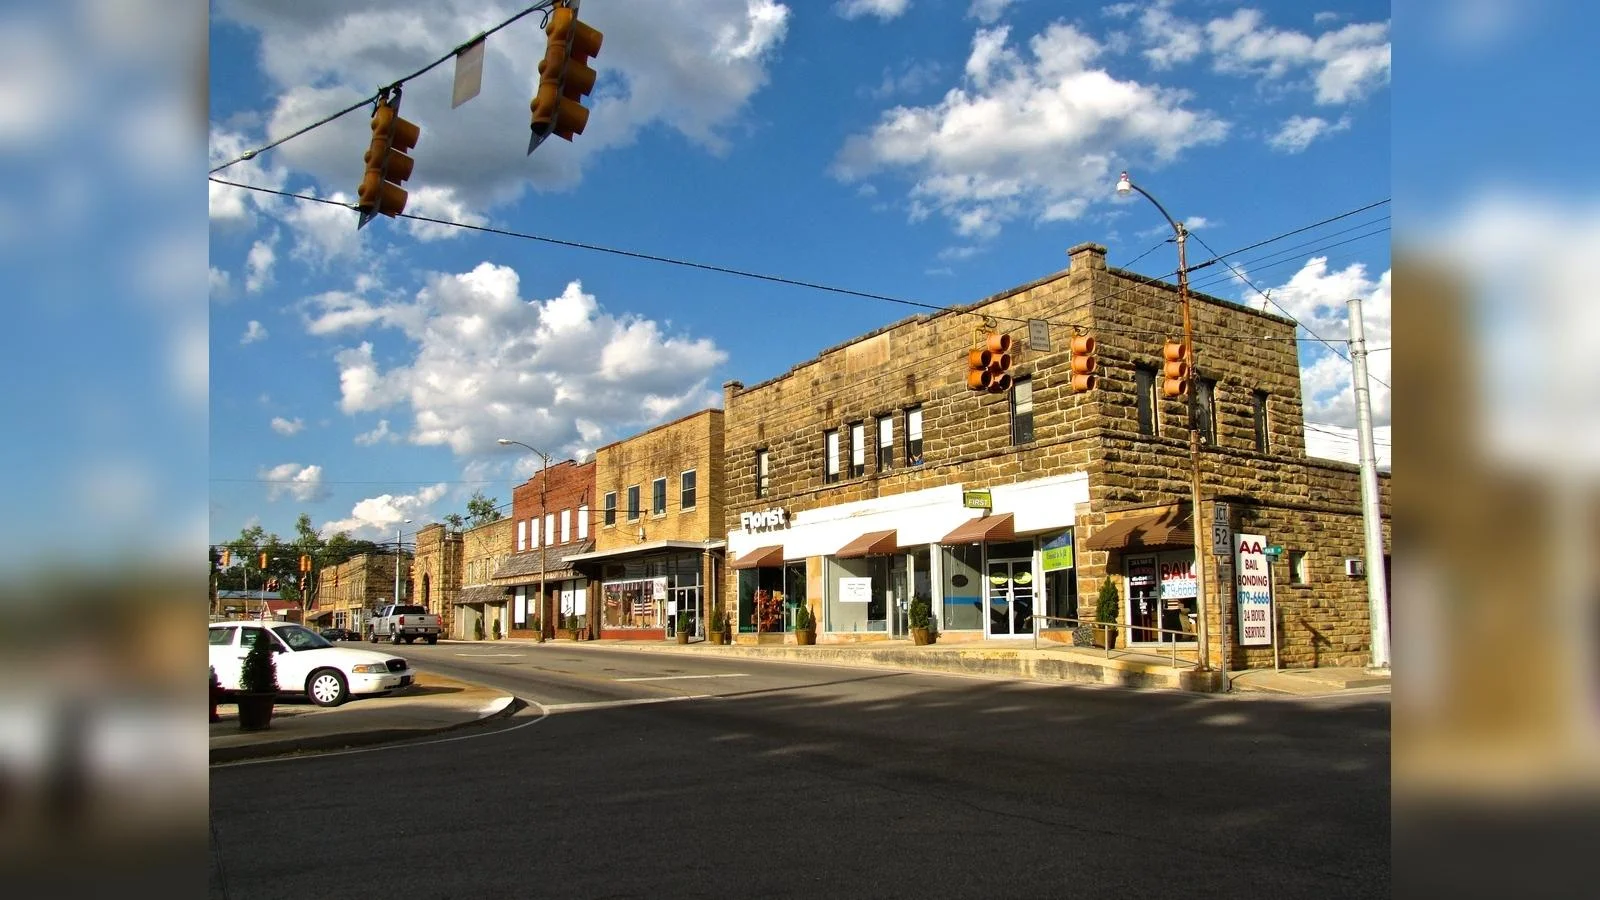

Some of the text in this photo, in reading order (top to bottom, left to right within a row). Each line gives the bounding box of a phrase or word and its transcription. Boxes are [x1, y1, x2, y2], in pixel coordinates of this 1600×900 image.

[741, 506, 785, 530] Florist
[1215, 507, 1227, 519] JCT
[1215, 528, 1228, 545] 52
[1239, 541, 1263, 554] AA
[1161, 560, 1197, 580] BAIL
[1245, 559, 1259, 570] BAIL
[1237, 575, 1267, 586] BONDING
[1238, 591, 1269, 604] 879-6666
[1244, 610, 1265, 621] 24 HOUR
[1245, 627, 1265, 638] SERVICE
